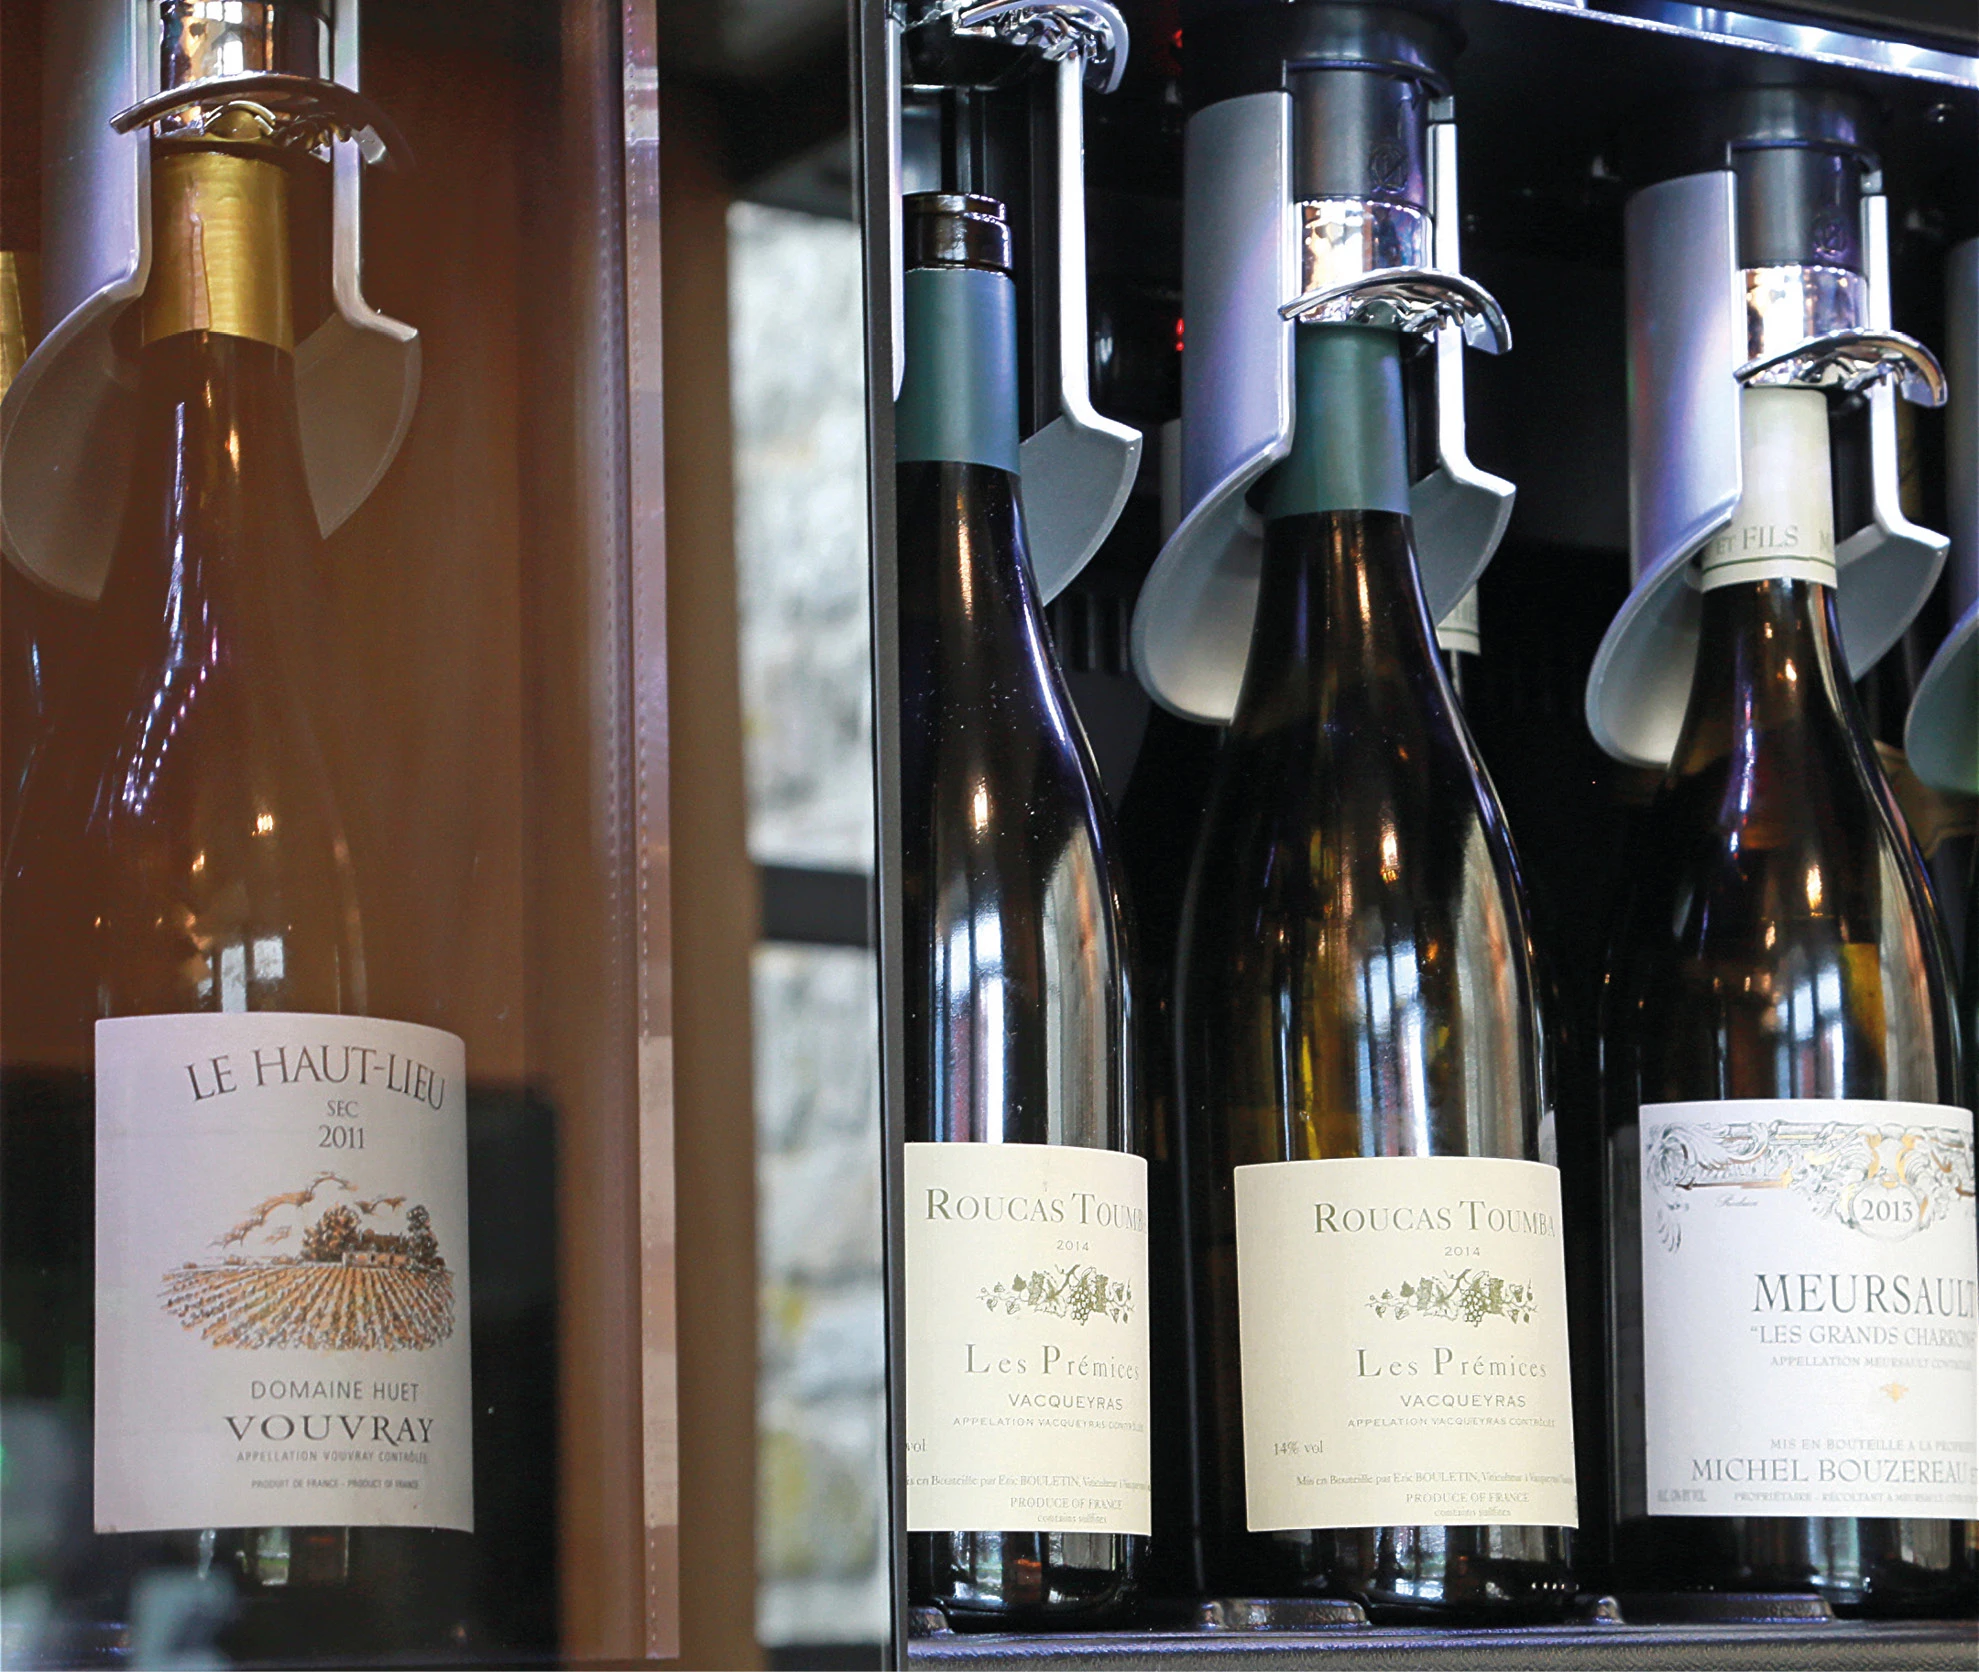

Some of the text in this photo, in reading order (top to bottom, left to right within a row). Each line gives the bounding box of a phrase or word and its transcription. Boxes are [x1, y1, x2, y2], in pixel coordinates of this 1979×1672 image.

[1743, 525, 1799, 550] FILS
[184, 1045, 446, 1111] LE HAUT-LIEU
[326, 1100, 359, 1118] SEC
[318, 1125, 365, 1149] 2011
[925, 1188, 1065, 1223] ROUCAS
[1861, 1200, 1913, 1223] 2013
[1314, 1201, 1556, 1238] ROUCAS TOUMBA
[1056, 1240, 1089, 1251] 2014
[1444, 1246, 1481, 1257] 2014
[1809, 1325, 1898, 1345] GRANDS
[965, 1343, 1140, 1381] Les Prémices
[1357, 1347, 1547, 1378] Les Prémices
[1770, 1356, 1861, 1368] APPELLATION
[251, 1380, 419, 1402] DOMAINE HUET
[1008, 1393, 1123, 1411] VACQUEYRAS
[1400, 1394, 1526, 1408] VACQUEYRAS
[224, 1414, 434, 1446] VOUVRAY
[953, 1417, 1034, 1427] APPELATION
[1347, 1417, 1426, 1427] APPELATION
[1430, 1417, 1507, 1426] VACQUEYRAS
[1273, 1440, 1324, 1456] 14% vol
[1770, 1439, 1796, 1450] MIS
[1801, 1439, 1821, 1450] EN
[1826, 1439, 1904, 1451] BOUTEILLE
[236, 1450, 318, 1463] APPELLATION
[323, 1450, 373, 1464] VOUVRAY
[1692, 1459, 1809, 1482] MICHEL
[1818, 1459, 1966, 1484] BOUZEREAU
[251, 1479, 289, 1490] PRODUIT
[307, 1479, 338, 1490] FRANCE
[1010, 1498, 1123, 1510] PRODUCE OF FRANCE
[1406, 1493, 1530, 1503] PRODUCE OF FRANCE
